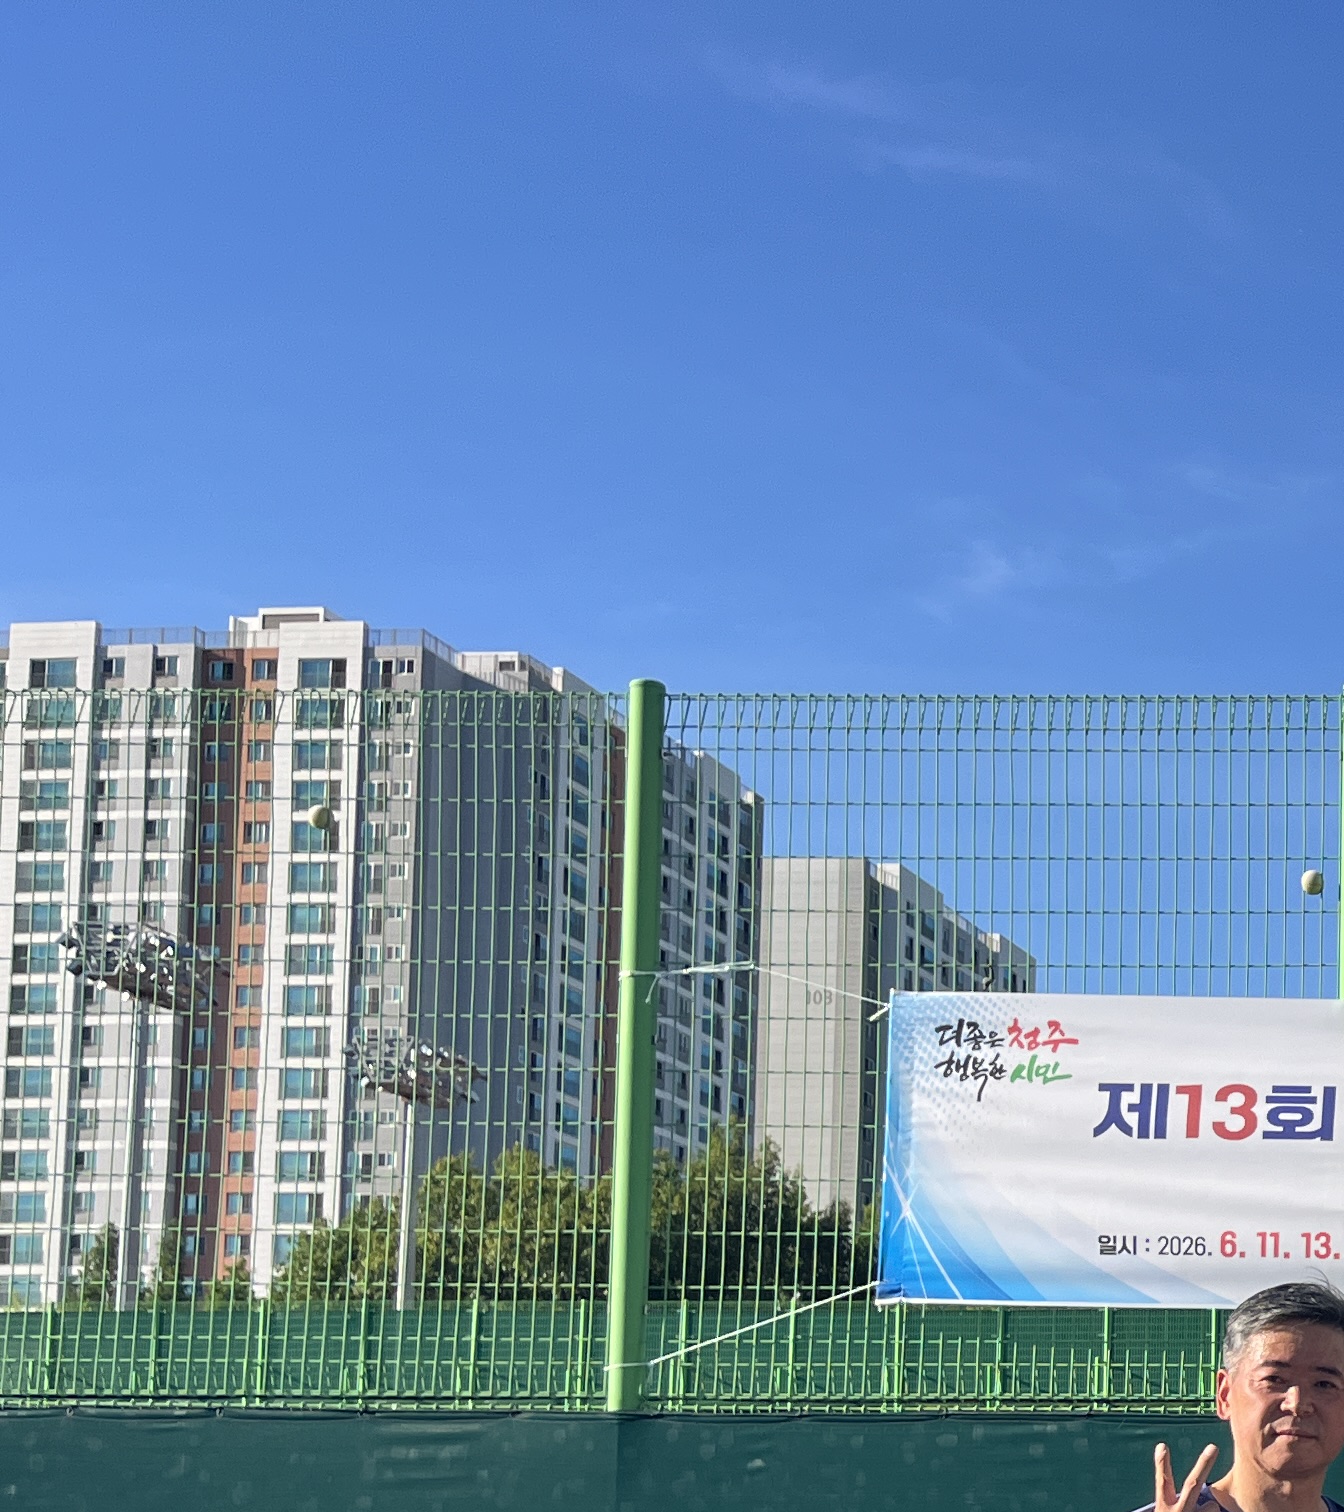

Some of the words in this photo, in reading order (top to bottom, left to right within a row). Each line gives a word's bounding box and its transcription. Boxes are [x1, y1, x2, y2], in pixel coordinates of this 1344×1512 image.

[1007, 1017, 1079, 1053] 청주
[934, 1050, 1008, 1102] 행복한
[1010, 1054, 1073, 1085] 시민
[1093, 1082, 1337, 1142] 제13회
[1157, 1235, 1213, 1256] 2026.
[1220, 1231, 1246, 1258] 6.
[1256, 1231, 1291, 1259] 11.
[1301, 1232, 1341, 1260] 13.
